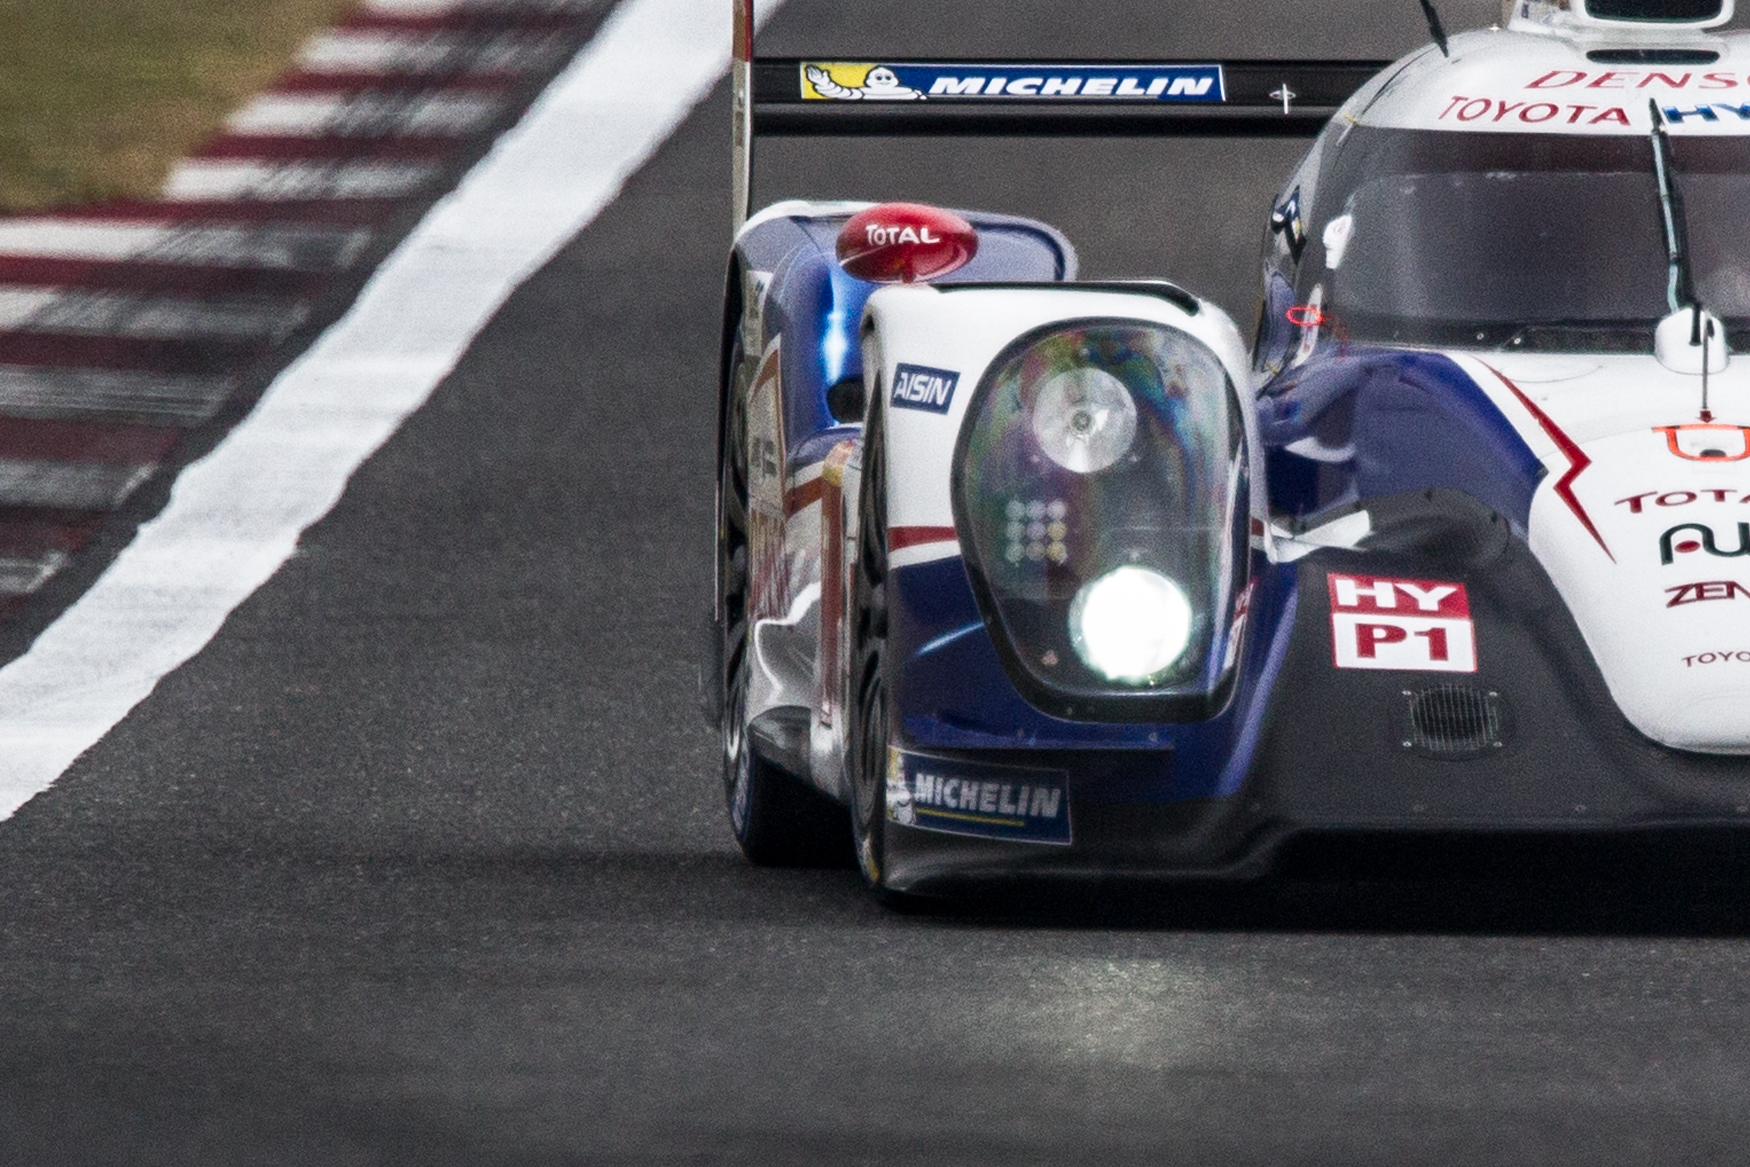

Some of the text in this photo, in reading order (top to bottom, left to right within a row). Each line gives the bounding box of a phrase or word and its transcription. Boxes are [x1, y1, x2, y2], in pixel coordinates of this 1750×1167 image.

[927, 77, 1214, 96] MICHELIN
[1438, 95, 1632, 126] TOYOTA
[865, 224, 941, 246] TOTAL
[893, 371, 952, 407] AISIN
[1335, 578, 1458, 612] HY
[1355, 622, 1449, 662] P1
[914, 772, 1062, 819] MICHELIN
